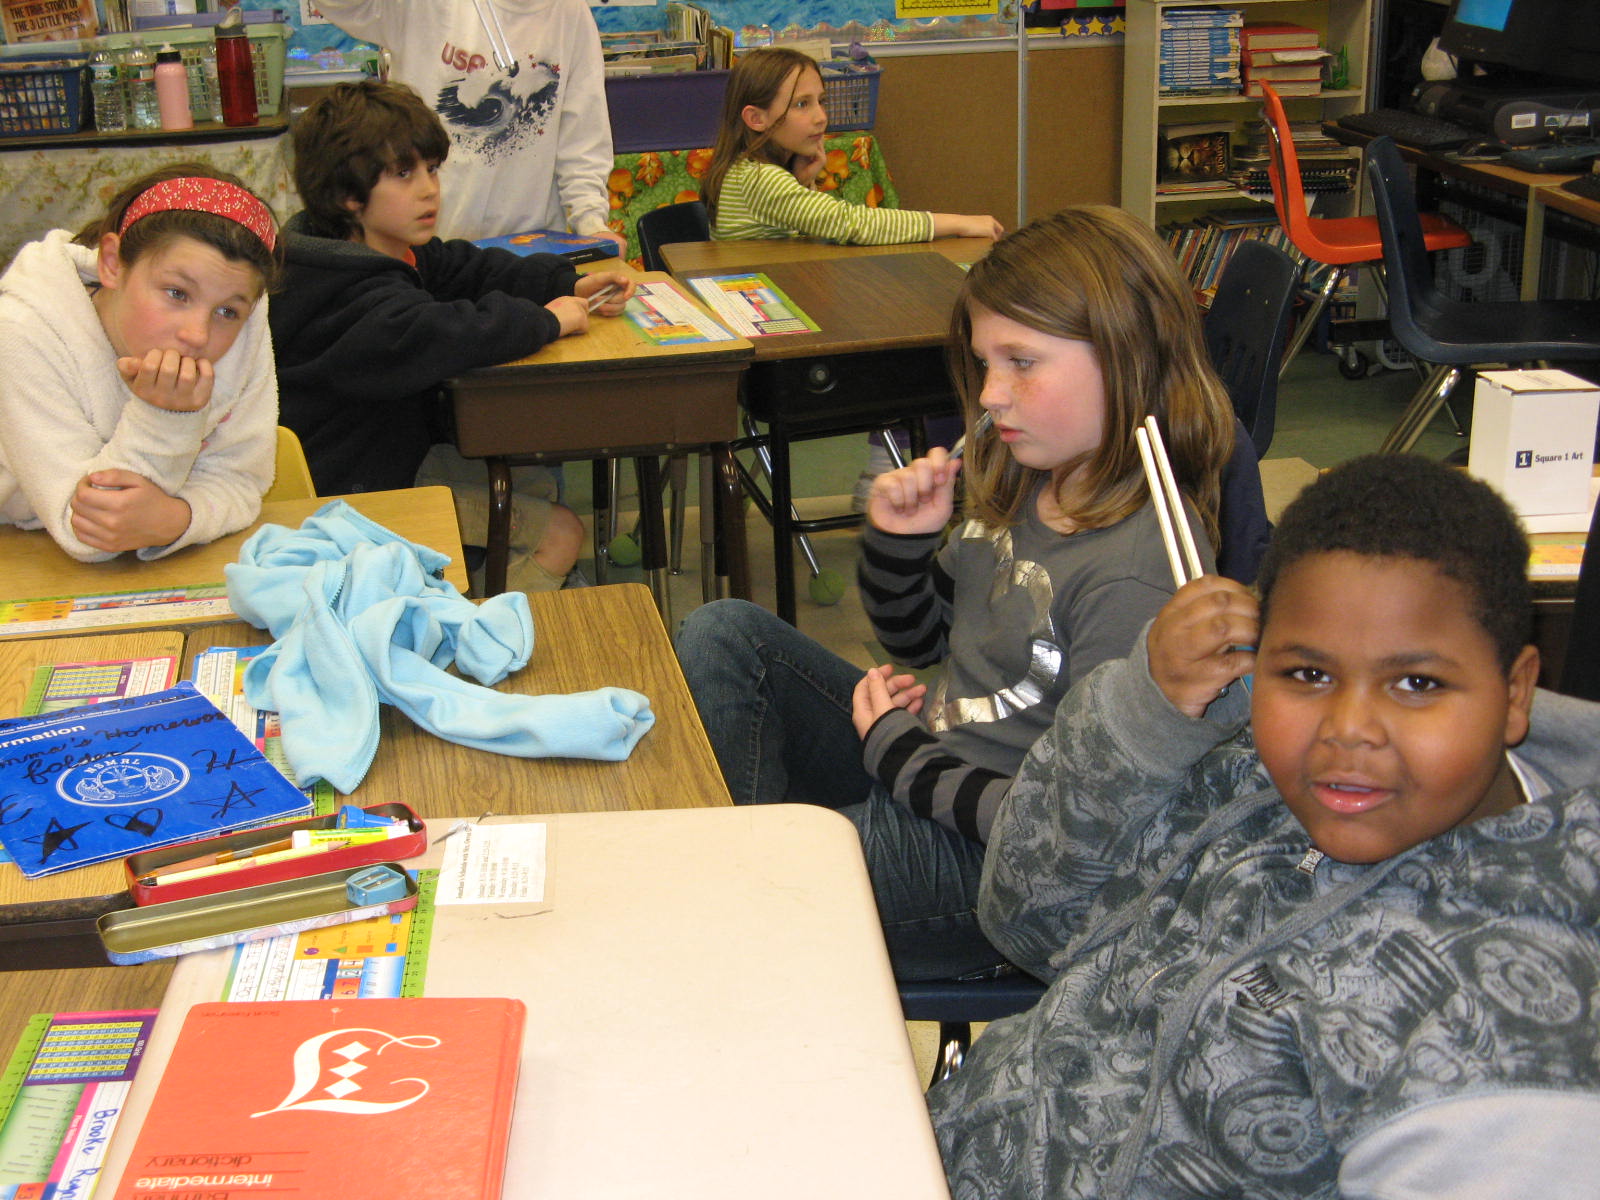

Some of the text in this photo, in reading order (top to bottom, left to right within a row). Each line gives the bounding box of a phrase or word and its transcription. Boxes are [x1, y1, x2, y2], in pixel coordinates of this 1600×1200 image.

[10, 8, 25, 19] THE
[14, 21, 29, 32] THE
[29, 19, 36, 30] 3
[37, 15, 60, 29] LITTLE
[1535, 454, 1562, 464] Square
[1571, 451, 1583, 460] Art
[0, 725, 86, 750] rmation
[84, 758, 141, 775] NSMRL
[82, 1108, 119, 1155] Brooke
[146, 1154, 252, 1168] dictionary
[135, 1174, 273, 1190] intermediate
